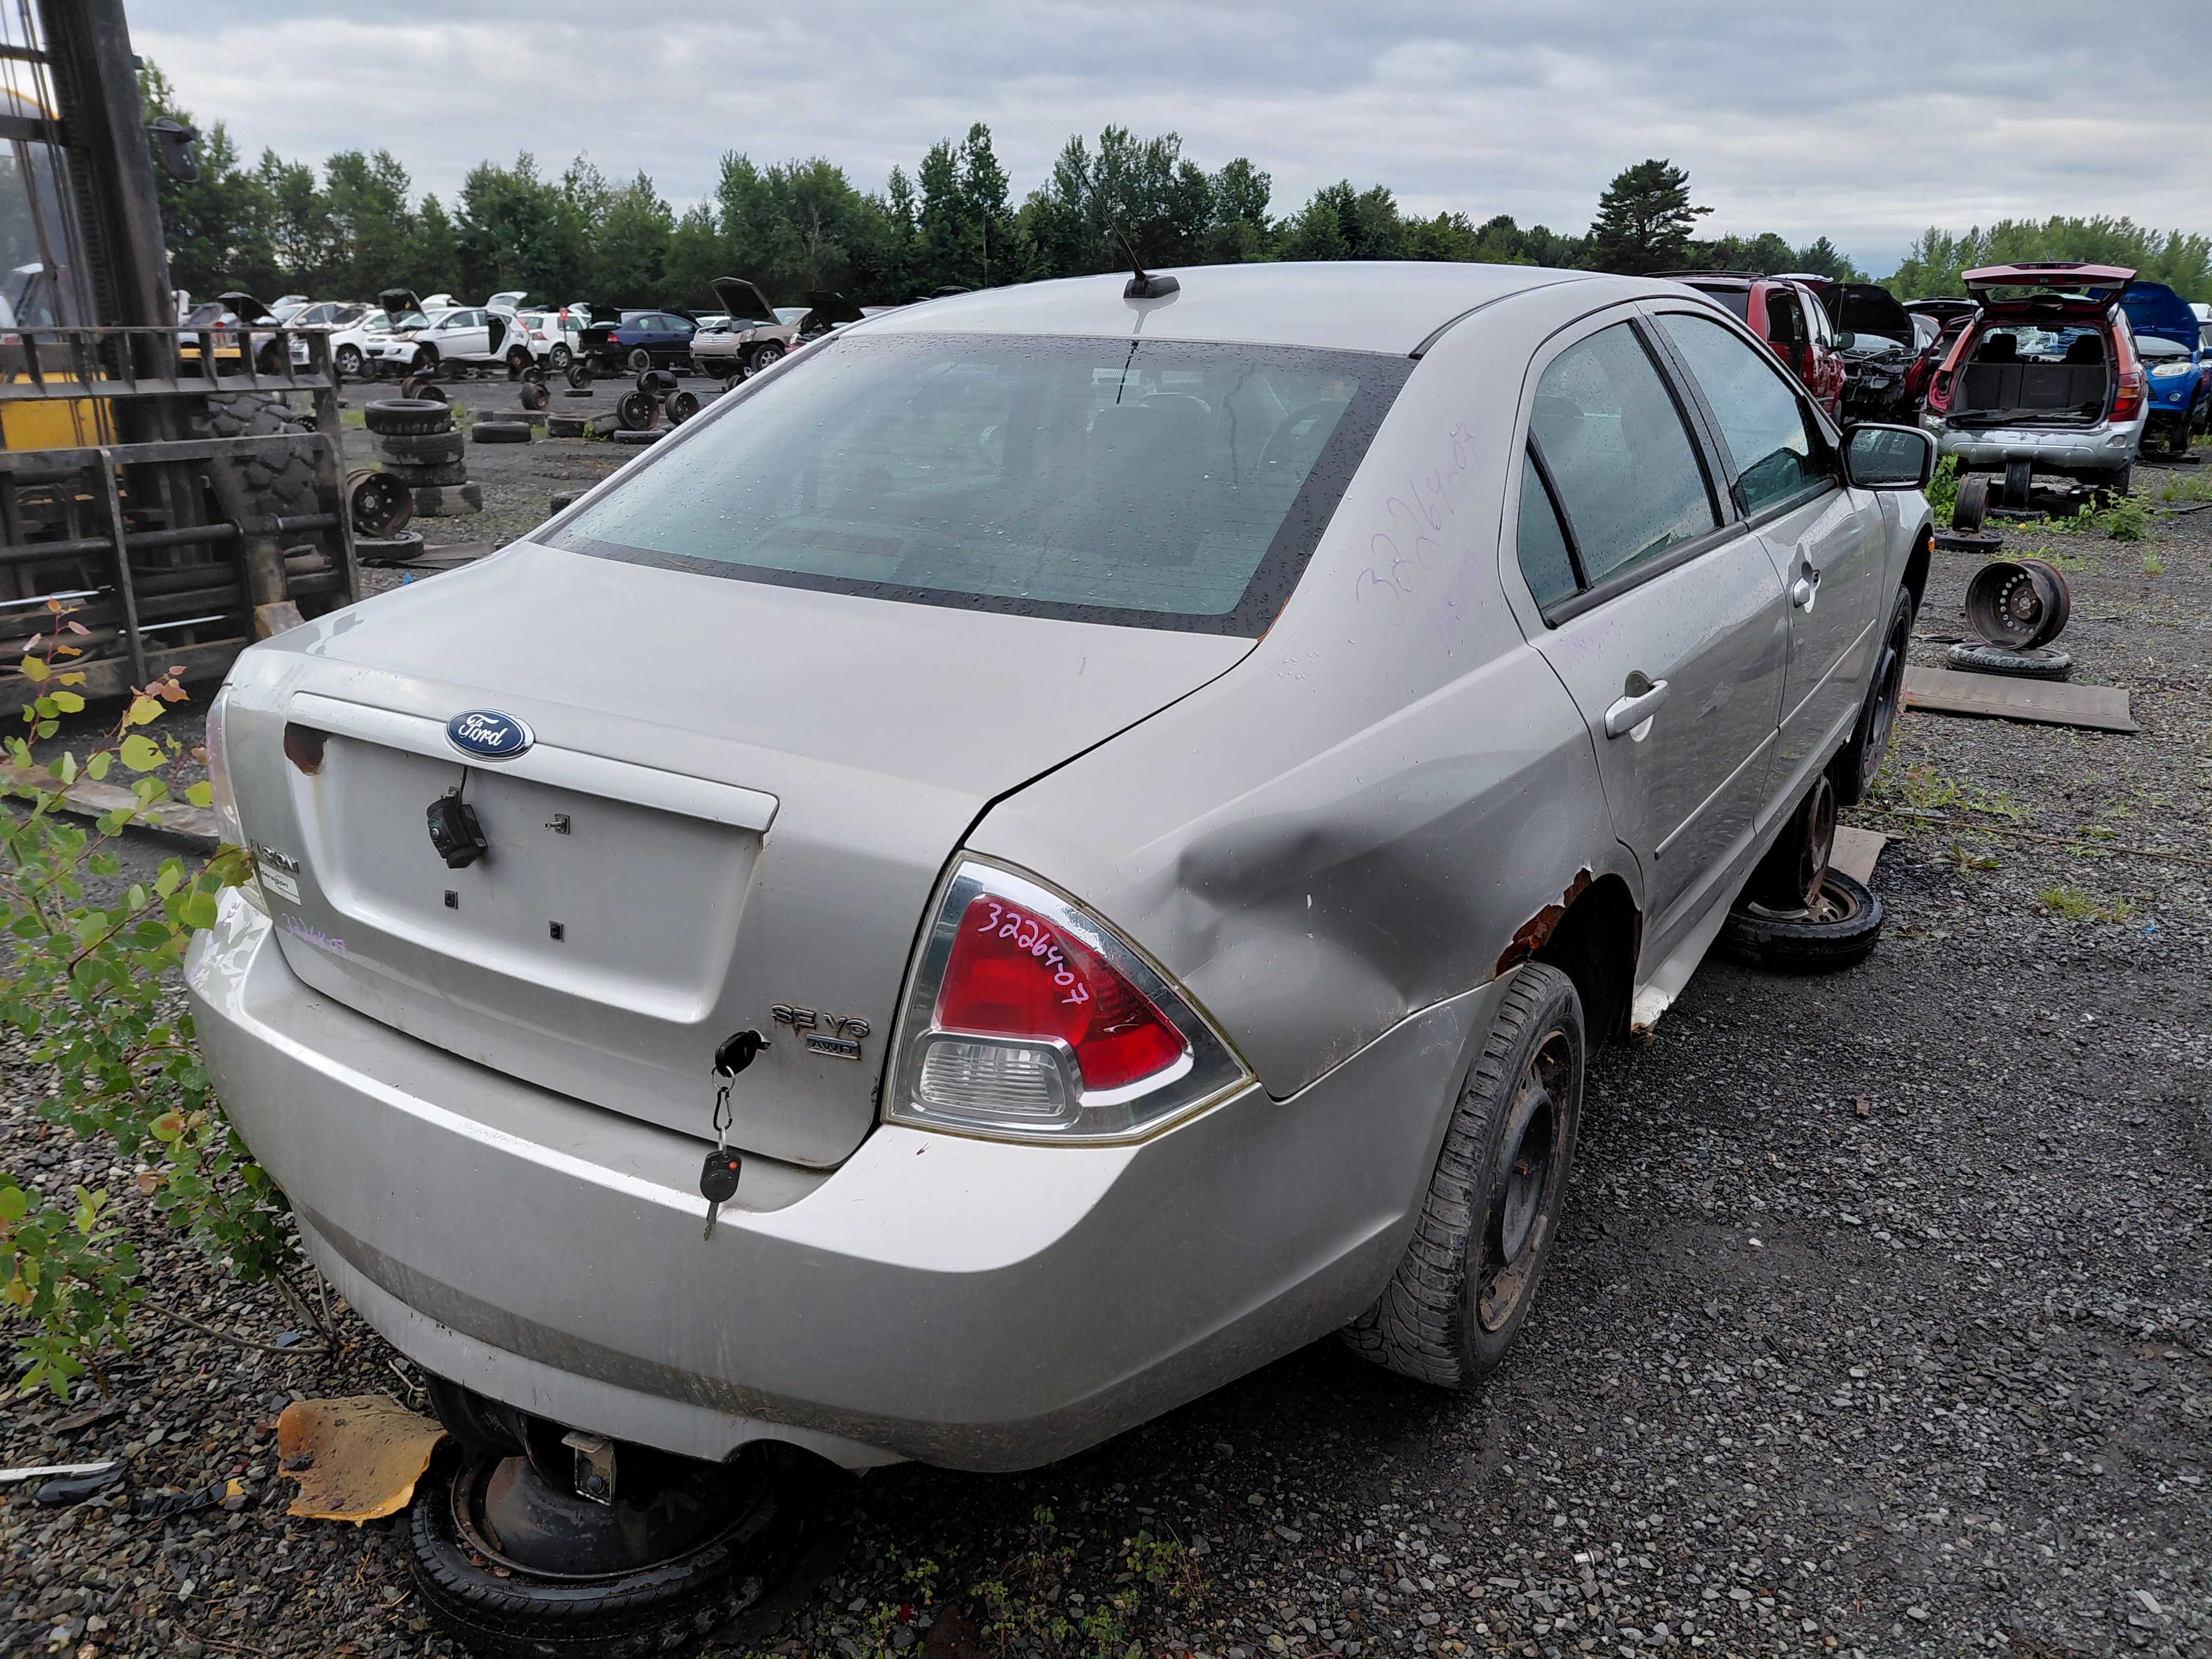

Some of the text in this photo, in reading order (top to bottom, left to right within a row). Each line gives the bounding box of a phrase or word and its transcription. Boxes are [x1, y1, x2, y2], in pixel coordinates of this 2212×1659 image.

[458, 714, 509, 747] Ford
[977, 903, 1089, 1005] 32264-07
[770, 1004, 870, 1038] SE V6
[811, 1040, 853, 1055] AWD
